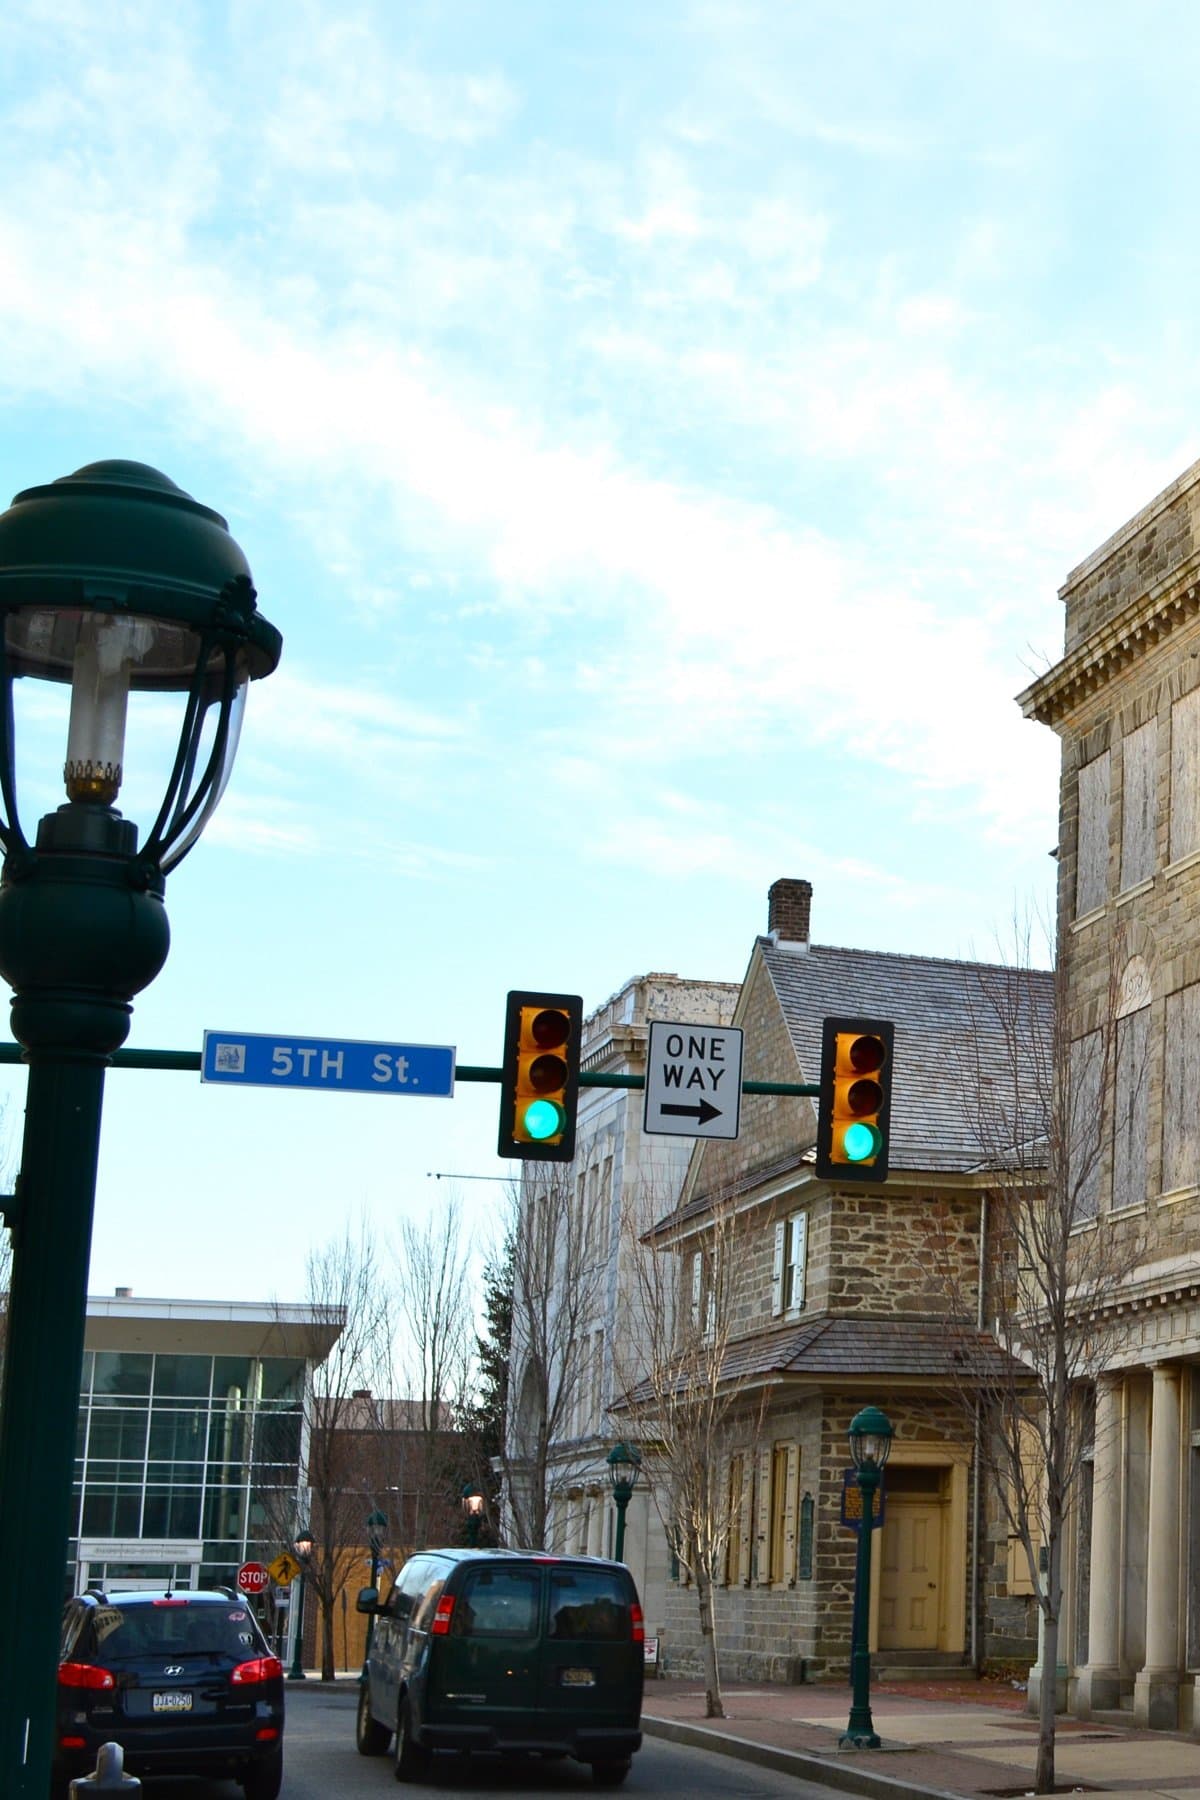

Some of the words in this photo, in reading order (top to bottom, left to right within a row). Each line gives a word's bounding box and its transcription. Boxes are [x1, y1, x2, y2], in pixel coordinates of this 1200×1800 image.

[665, 1033, 725, 1061] ONE
[272, 1046, 344, 1080] 5TH
[371, 1053, 419, 1085] St.
[663, 1063, 726, 1092] WAY
[240, 1571, 268, 1584] STOP
